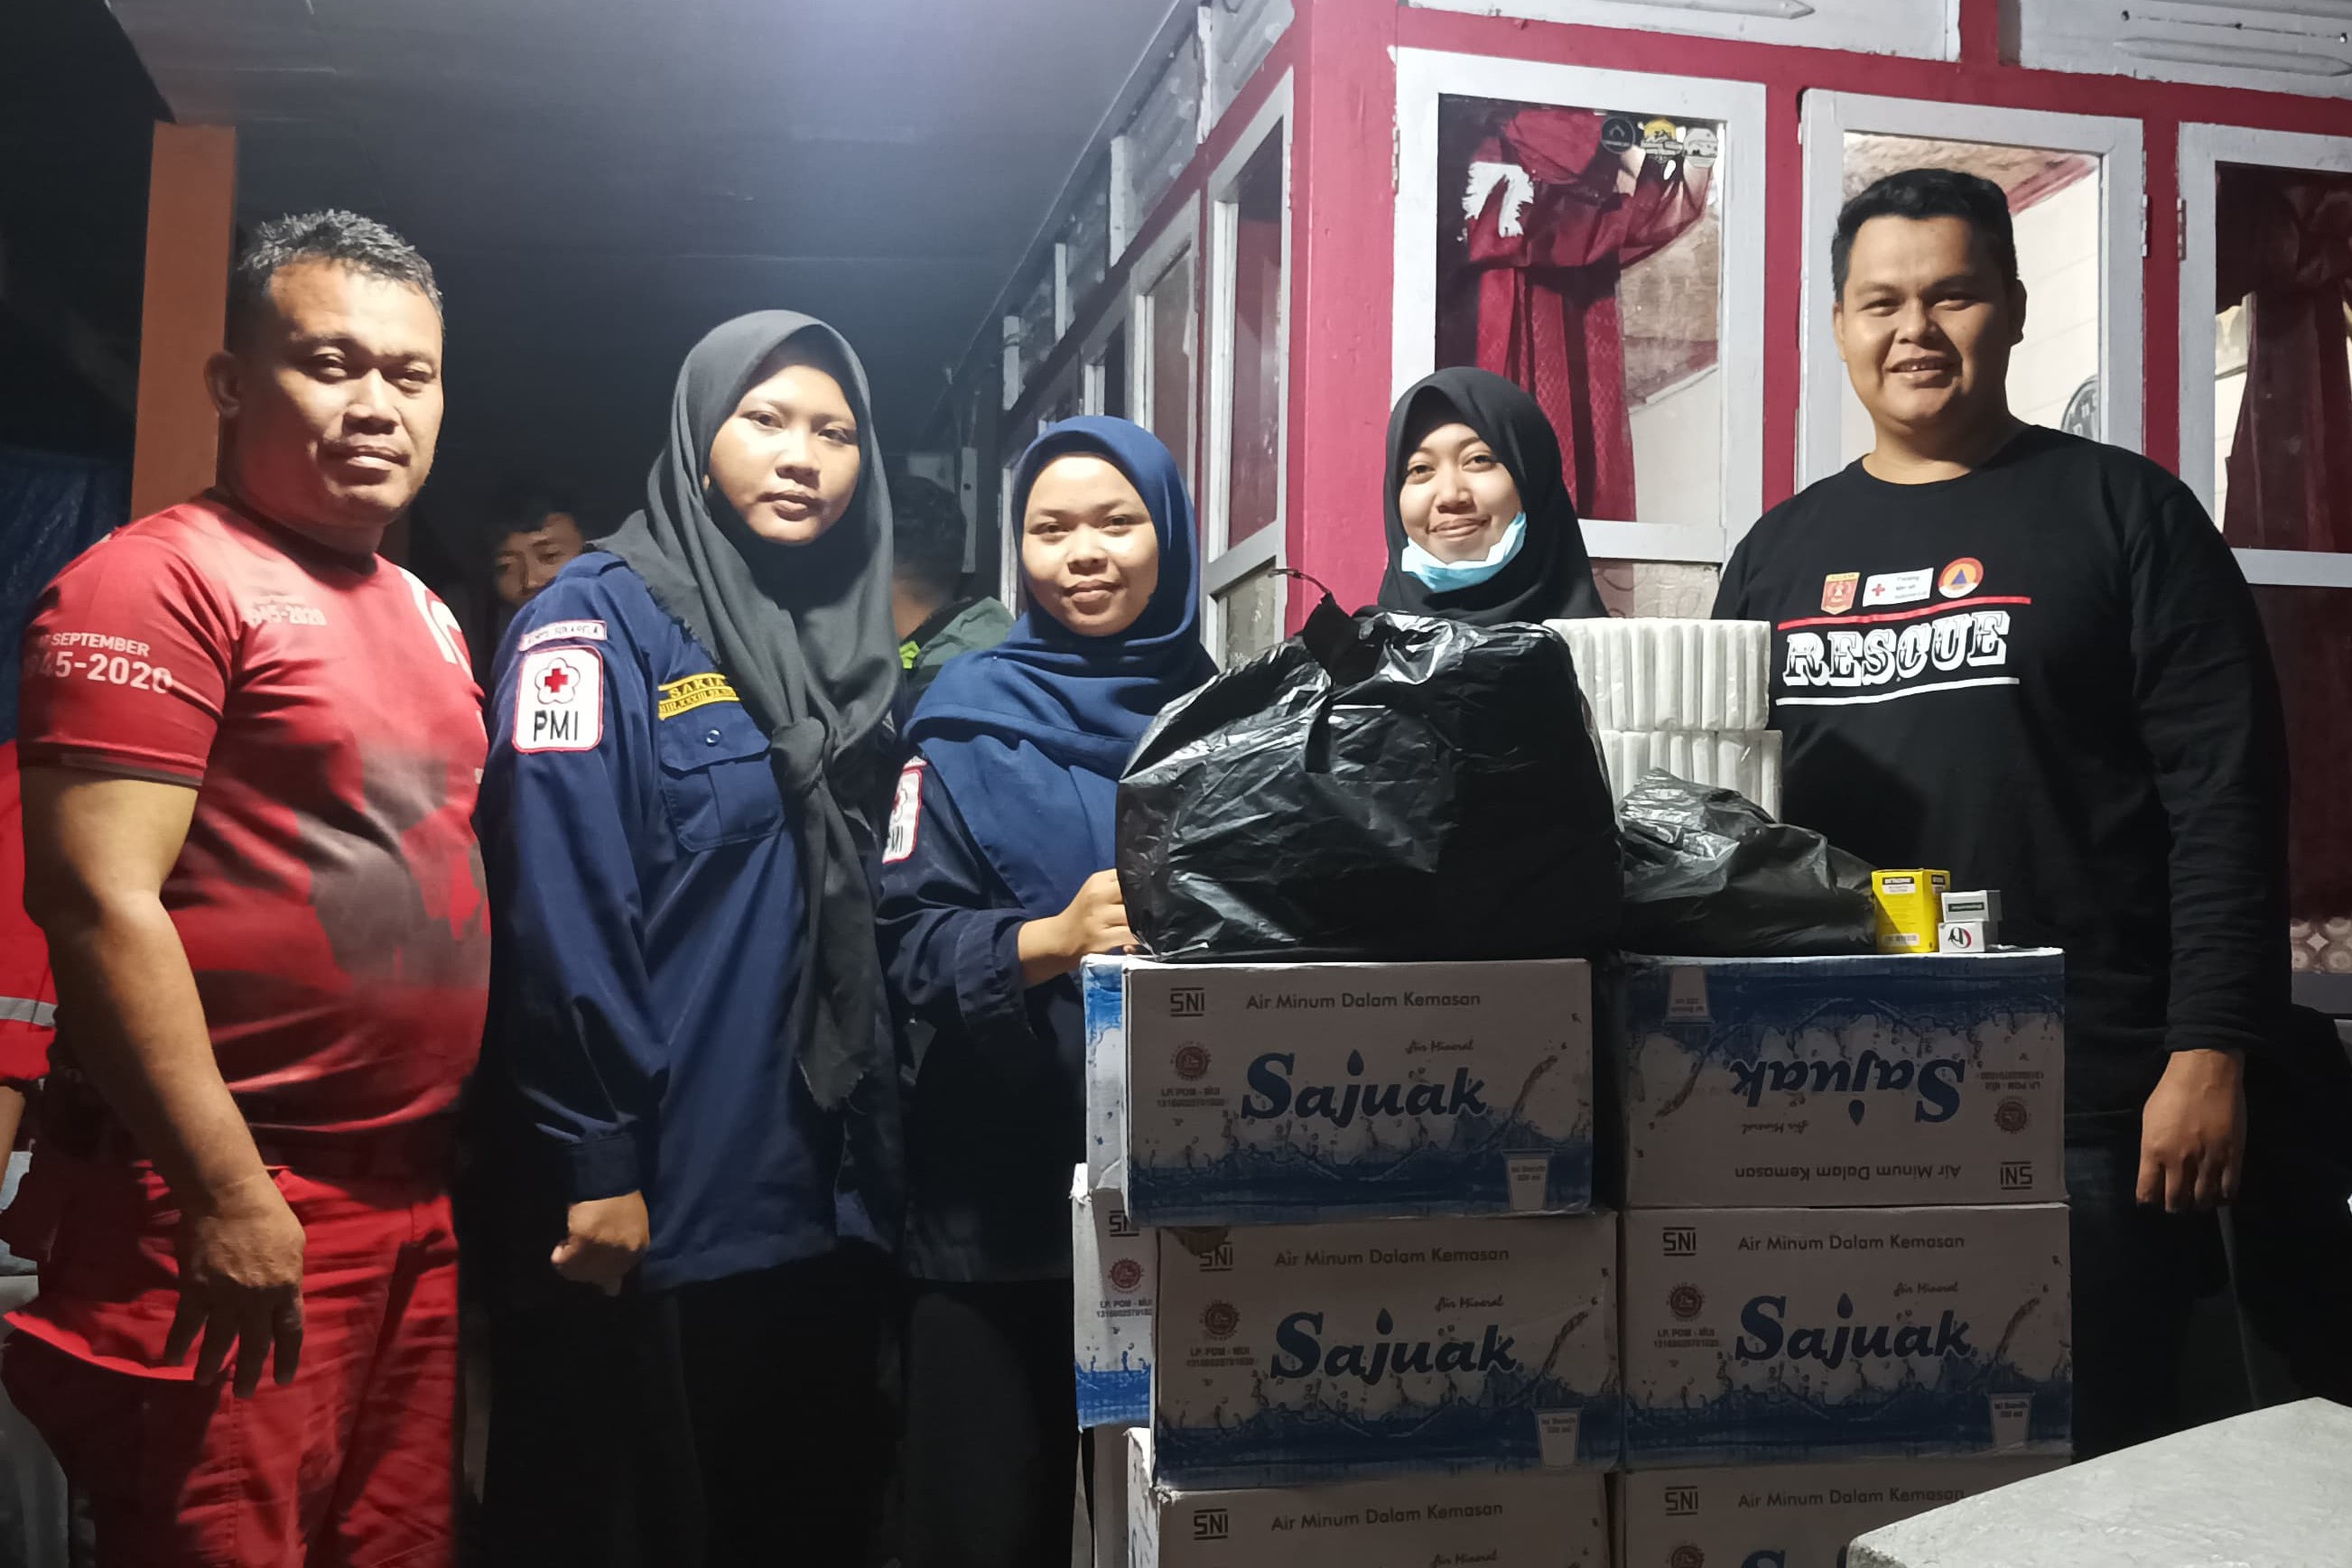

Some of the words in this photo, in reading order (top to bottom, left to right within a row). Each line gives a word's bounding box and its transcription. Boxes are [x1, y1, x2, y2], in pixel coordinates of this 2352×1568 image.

[51, 632, 151, 657] SEPTEMBER
[1782, 610, 2011, 687] RESCUE
[533, 710, 579, 742] PMI
[1170, 993, 1204, 1012] SNI
[1246, 993, 1271, 1010] Air
[1276, 992, 1336, 1009] Minum
[1342, 991, 1398, 1008] Dalam
[1404, 990, 1482, 1007] Kemasan
[1241, 1049, 1488, 1128] Sajuak
[1729, 1050, 1966, 1127] Sajuak
[1734, 1165, 1810, 1181] Kemasan
[1817, 1164, 1870, 1181] Dalam
[1876, 1164, 1933, 1180] Minum
[1938, 1164, 1961, 1180] Air
[2000, 1165, 2032, 1185] SNI
[1662, 1231, 1697, 1251] SNI
[1737, 1235, 1762, 1251] Air
[1766, 1235, 1824, 1251] Minum
[1829, 1234, 1883, 1250] Dalam
[1890, 1233, 1965, 1248] Kemasan
[1199, 1246, 1233, 1267] SNI
[1275, 1250, 1298, 1266] Air
[1304, 1250, 1363, 1266] Minum
[1369, 1248, 1426, 1265] Dalam
[1431, 1247, 1510, 1263] Kemasan
[1734, 1293, 1972, 1369] Sajuak
[1269, 1308, 1519, 1386] Sajuak
[1665, 1491, 1699, 1512] SNI
[1737, 1494, 1762, 1509] Air
[1766, 1491, 1824, 1508] Minum
[1829, 1489, 1884, 1505] Dalam
[1889, 1487, 1965, 1502] Kemasan
[1194, 1514, 1229, 1535] SNI
[1271, 1516, 1295, 1532] Air
[1300, 1512, 1360, 1529] Minum
[1365, 1508, 1422, 1525] Dalam
[1427, 1502, 1504, 1520] Kemasan
